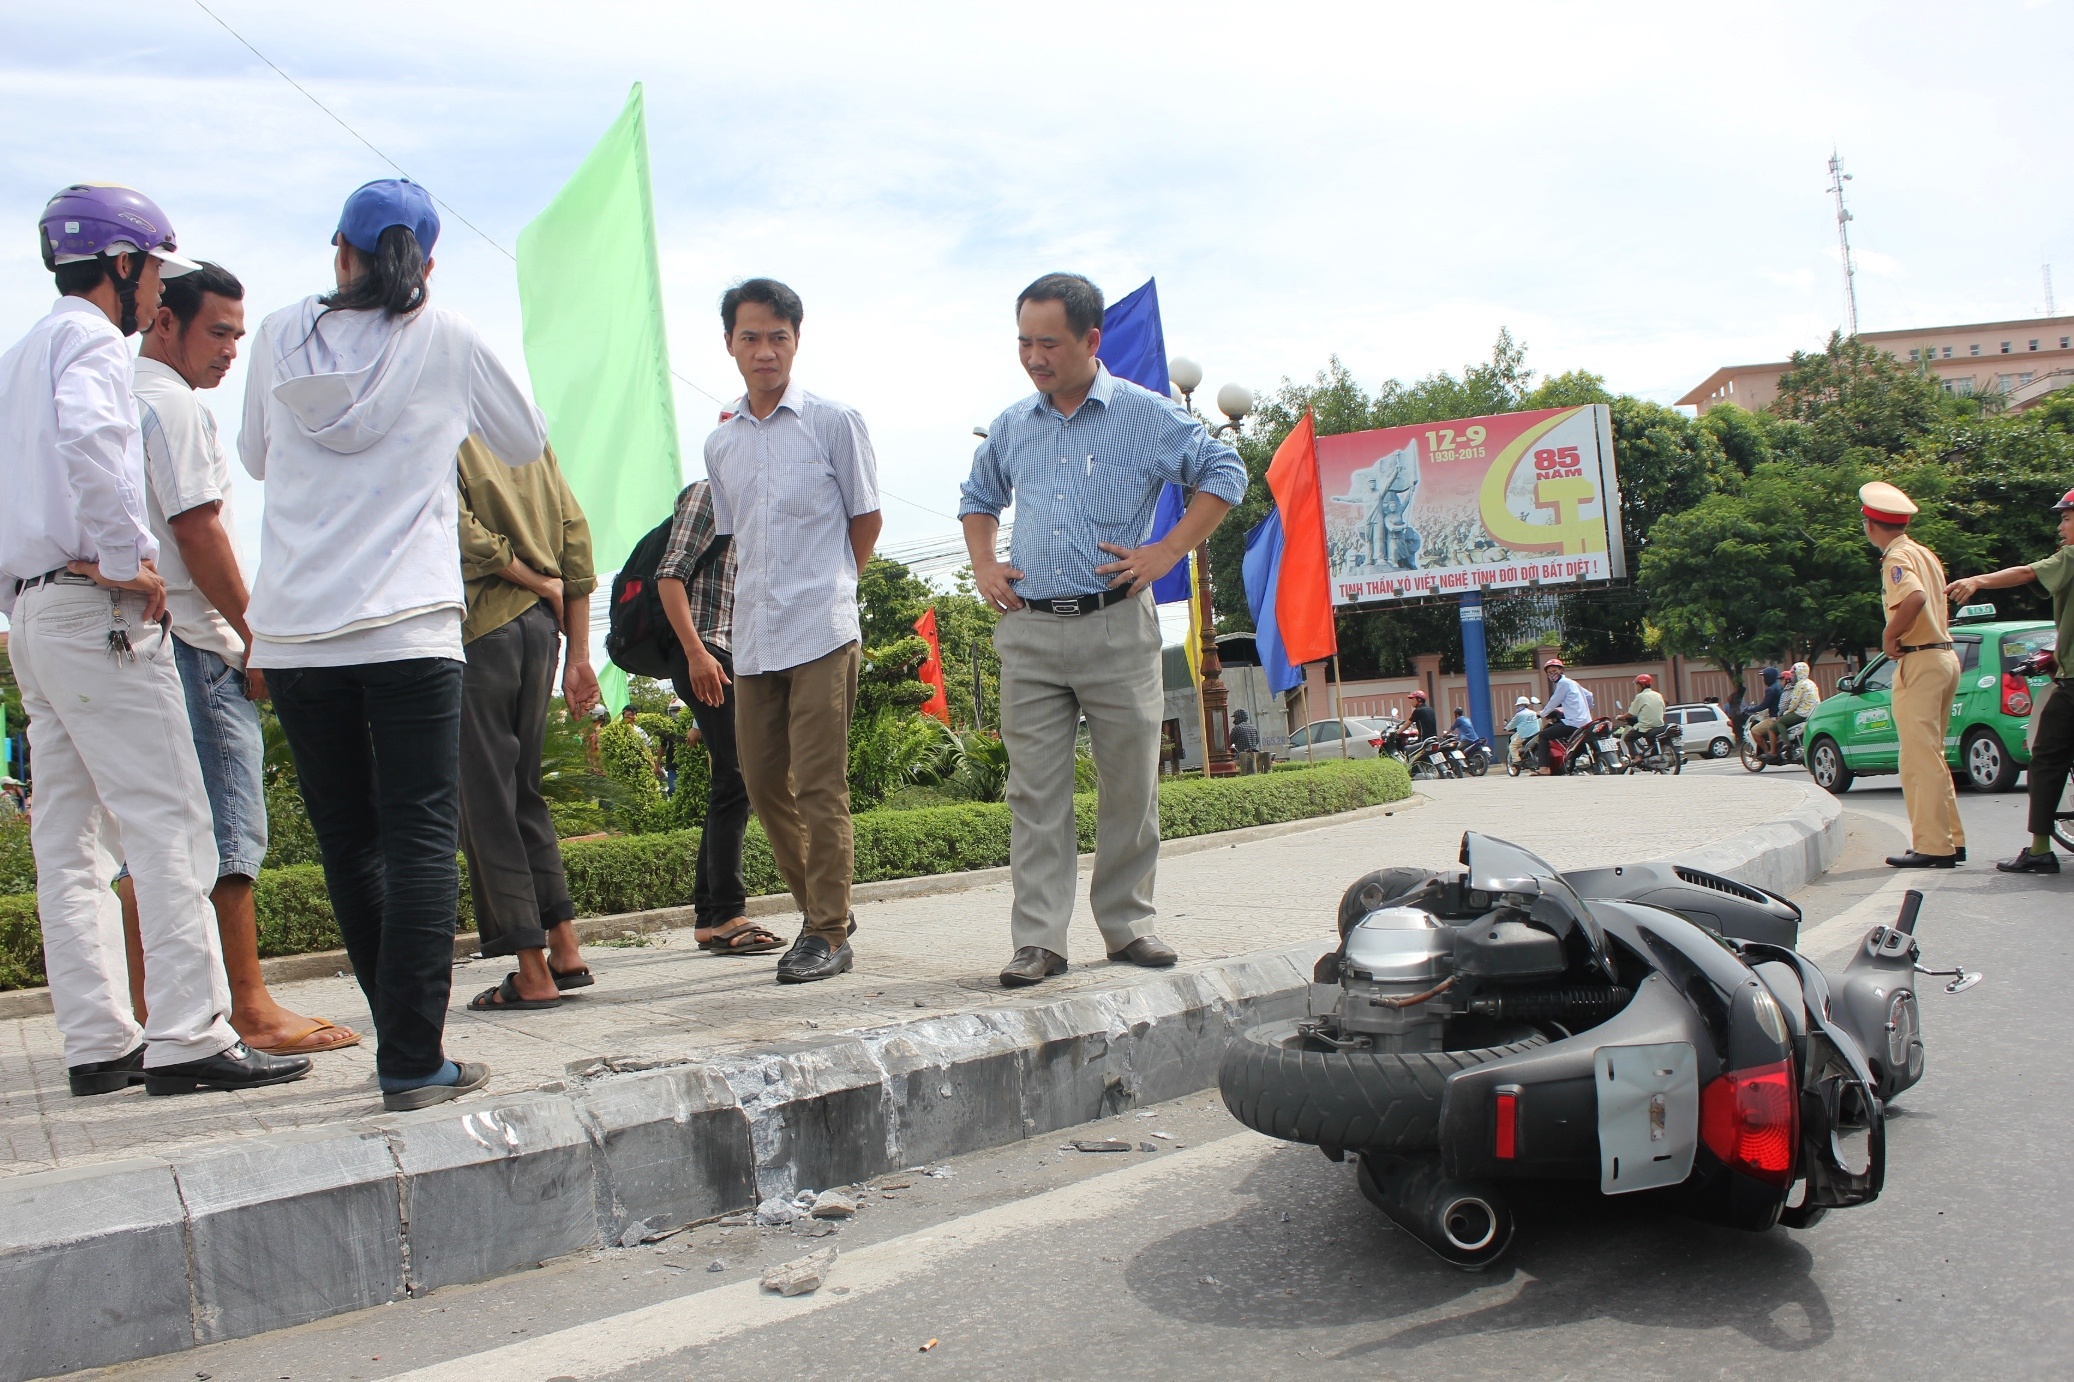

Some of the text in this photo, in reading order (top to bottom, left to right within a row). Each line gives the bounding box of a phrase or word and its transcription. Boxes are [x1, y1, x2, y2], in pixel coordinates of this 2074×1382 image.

[1425, 425, 1487, 451] 12-9
[1429, 447, 1486, 463] 1930-2015
[1534, 446, 1580, 470] 85
[1536, 468, 1583, 481] NĂM
[1338, 582, 1364, 598] TINH
[1414, 571, 1436, 591] VIẾT
[1440, 570, 1468, 589] NGHỆ
[1471, 568, 1496, 586] TĨNH
[1499, 564, 1518, 583] ĐỜI
[1521, 562, 1539, 581] ĐỜI
[1542, 559, 1563, 579] BẤT
